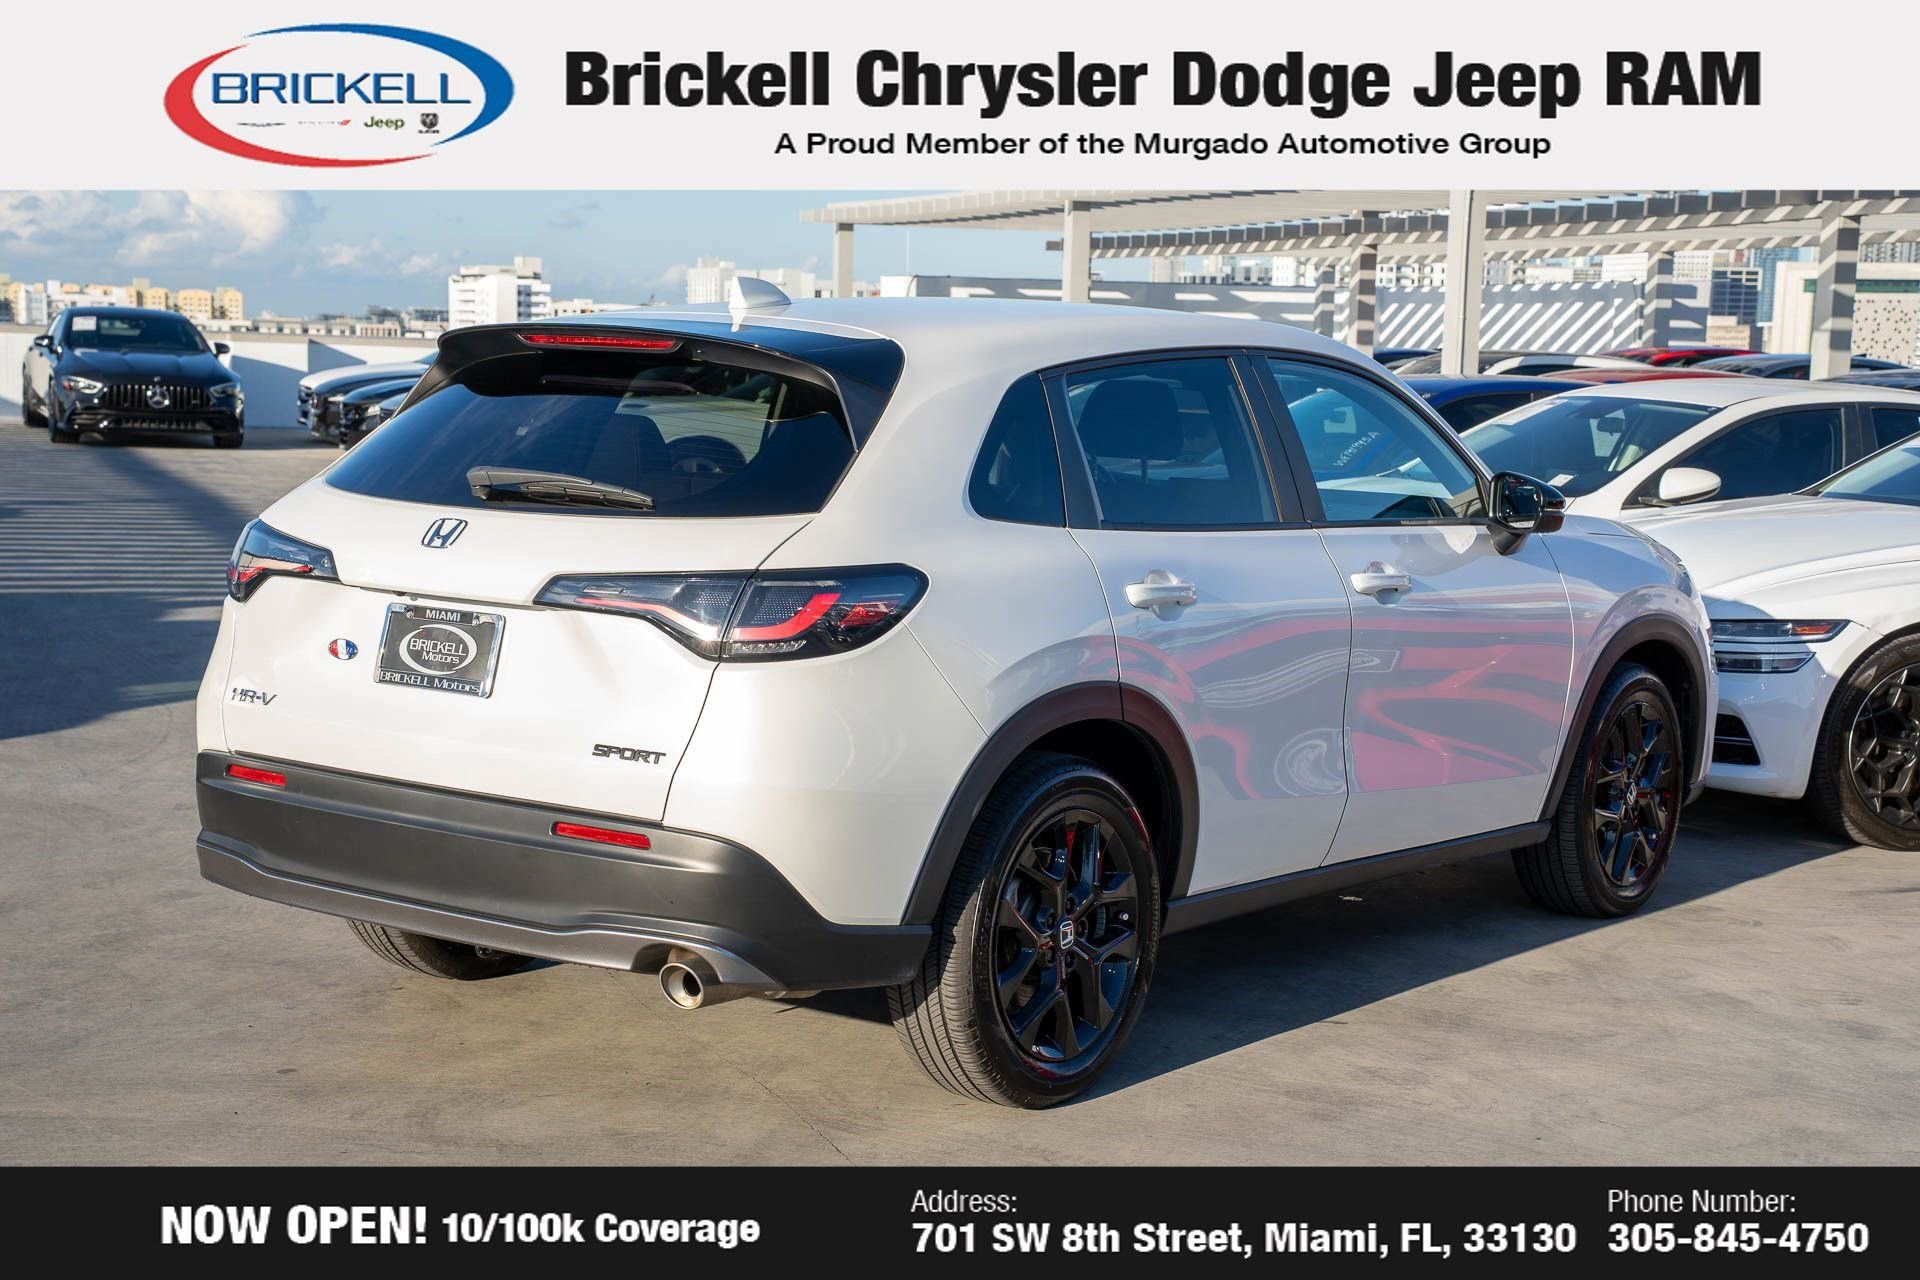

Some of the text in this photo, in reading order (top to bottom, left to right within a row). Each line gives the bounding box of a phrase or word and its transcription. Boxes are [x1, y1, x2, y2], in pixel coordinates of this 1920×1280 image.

[425, 609, 461, 622] MIAMI
[409, 638, 467, 656] BRICKELL
[422, 651, 460, 664] Motors
[379, 670, 480, 693] BRICKELL Motors
[231, 687, 278, 706] HR-V
[591, 743, 667, 765] SPORT
